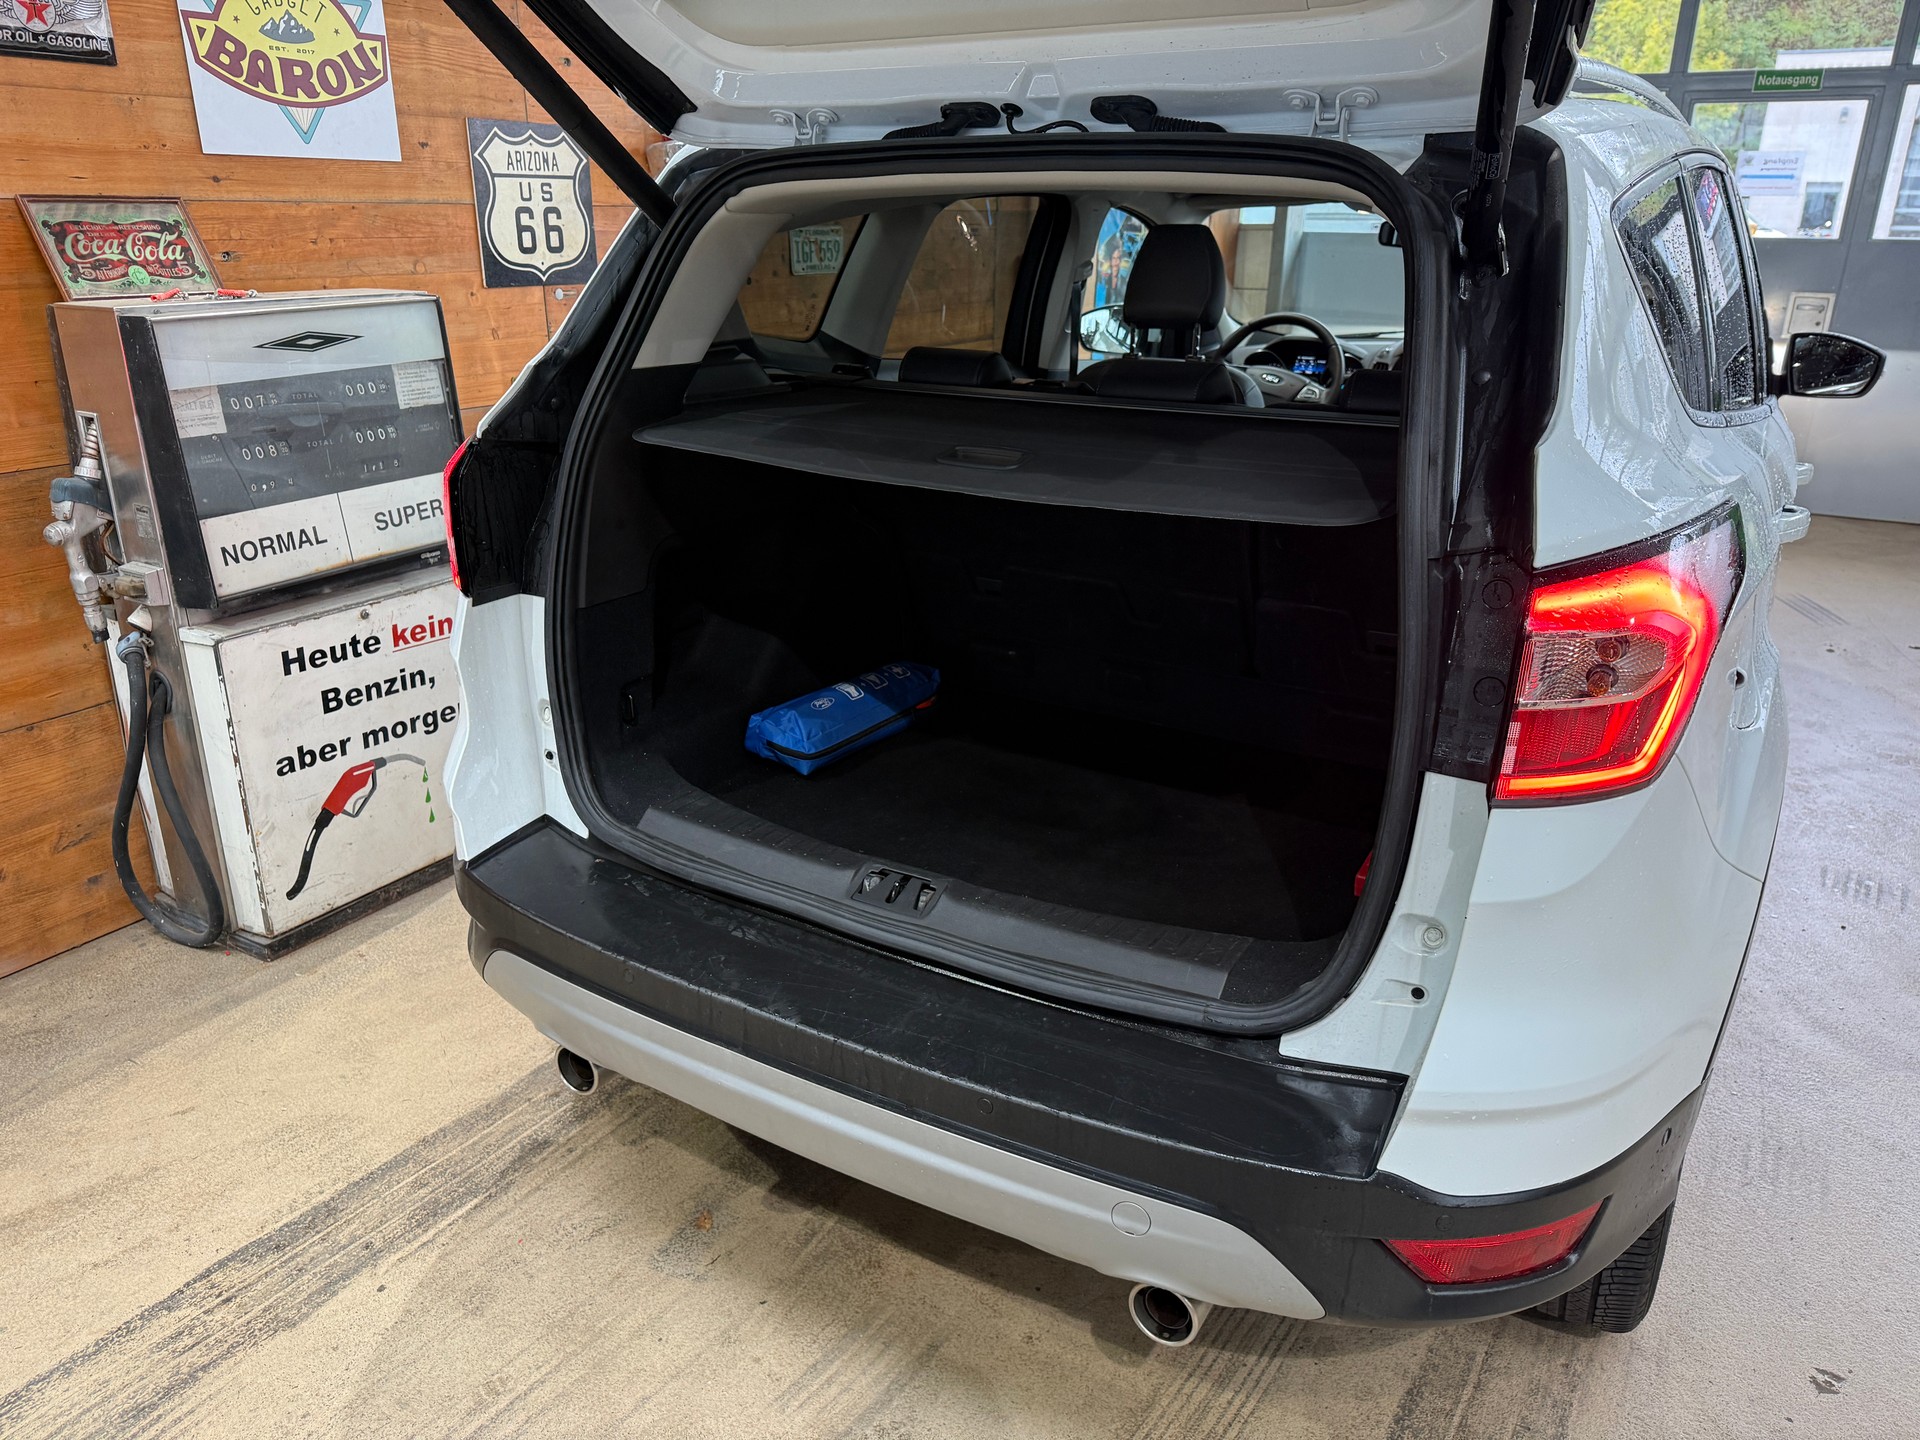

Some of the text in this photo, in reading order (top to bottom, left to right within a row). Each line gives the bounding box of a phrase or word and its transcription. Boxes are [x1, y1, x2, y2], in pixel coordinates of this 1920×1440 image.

[0, 29, 108, 51] R OIL GASOLINE
[201, 24, 382, 99] BARON
[1757, 74, 1819, 87] Notausgang
[507, 151, 560, 172] ARIZONA
[515, 206, 565, 255] 66
[345, 382, 377, 397] 000
[242, 444, 277, 461] 008
[307, 440, 334, 448] TOTAL
[355, 428, 386, 444] 000
[374, 498, 445, 531] SUPER
[220, 525, 328, 567] NORMAL
[281, 615, 453, 677] Heute kein
[321, 668, 435, 714] Benzin,
[276, 702, 460, 777] aber morge
